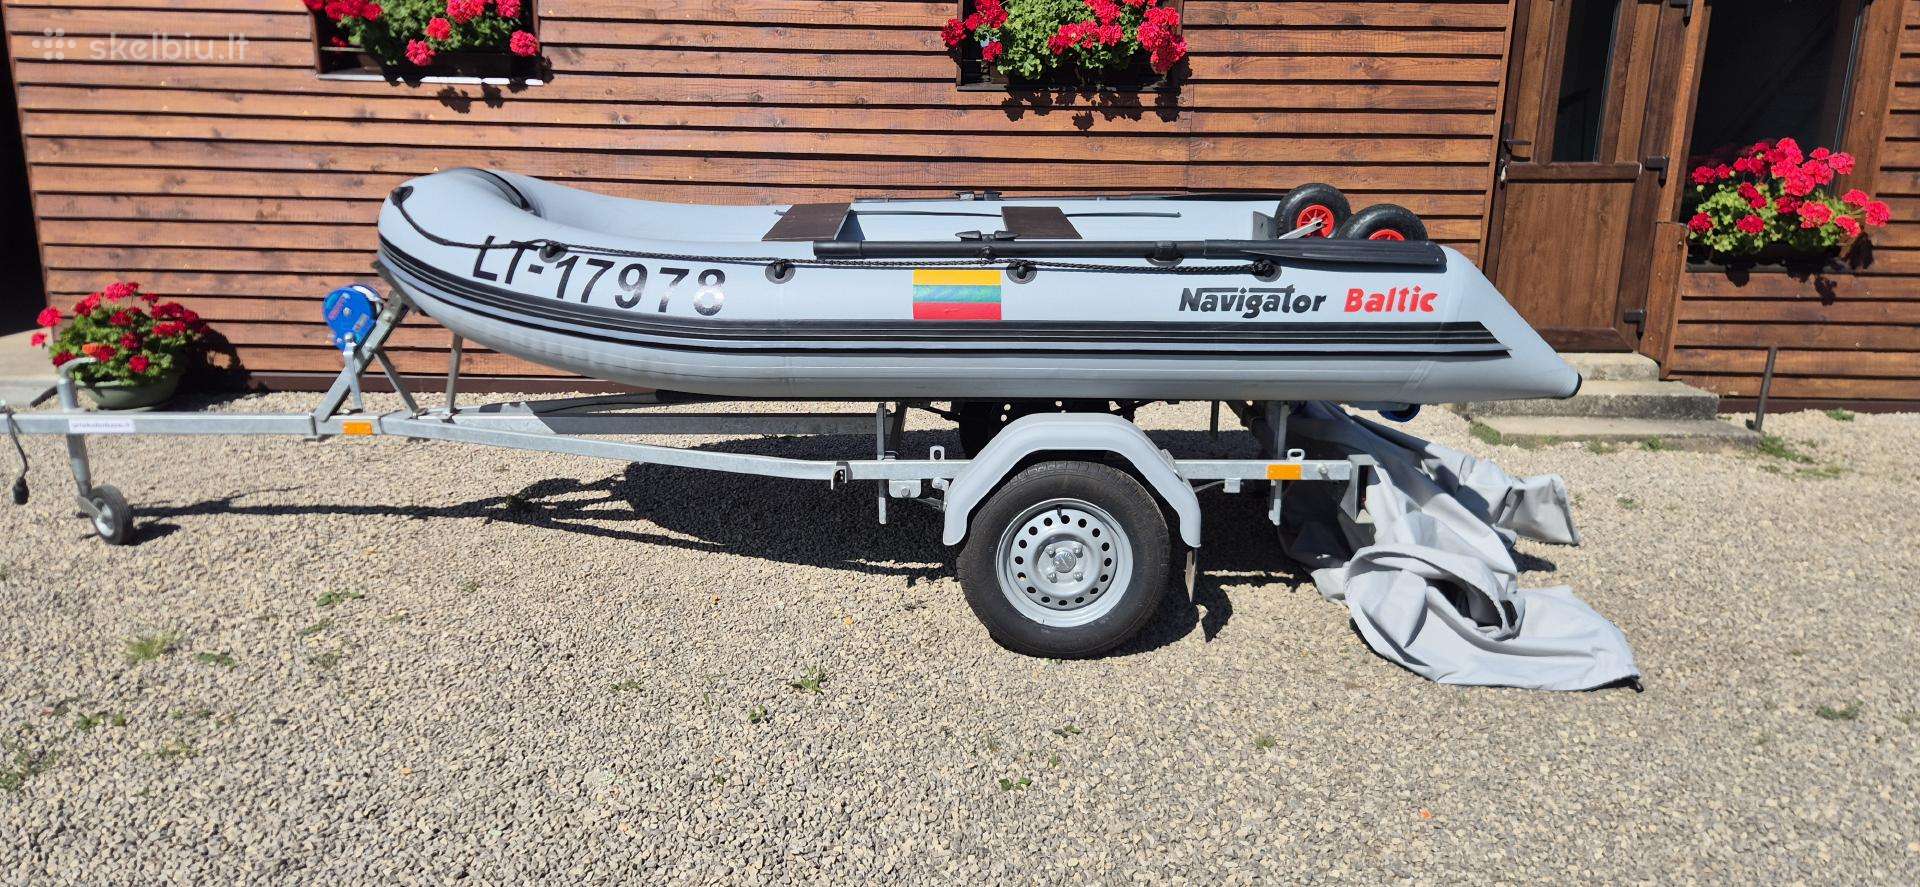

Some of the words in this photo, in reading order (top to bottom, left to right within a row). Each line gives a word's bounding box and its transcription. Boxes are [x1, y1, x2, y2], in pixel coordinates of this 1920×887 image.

[473, 235, 726, 316] LT-17978
[1178, 284, 1327, 319] Navigator
[1344, 285, 1438, 312] Baltic
